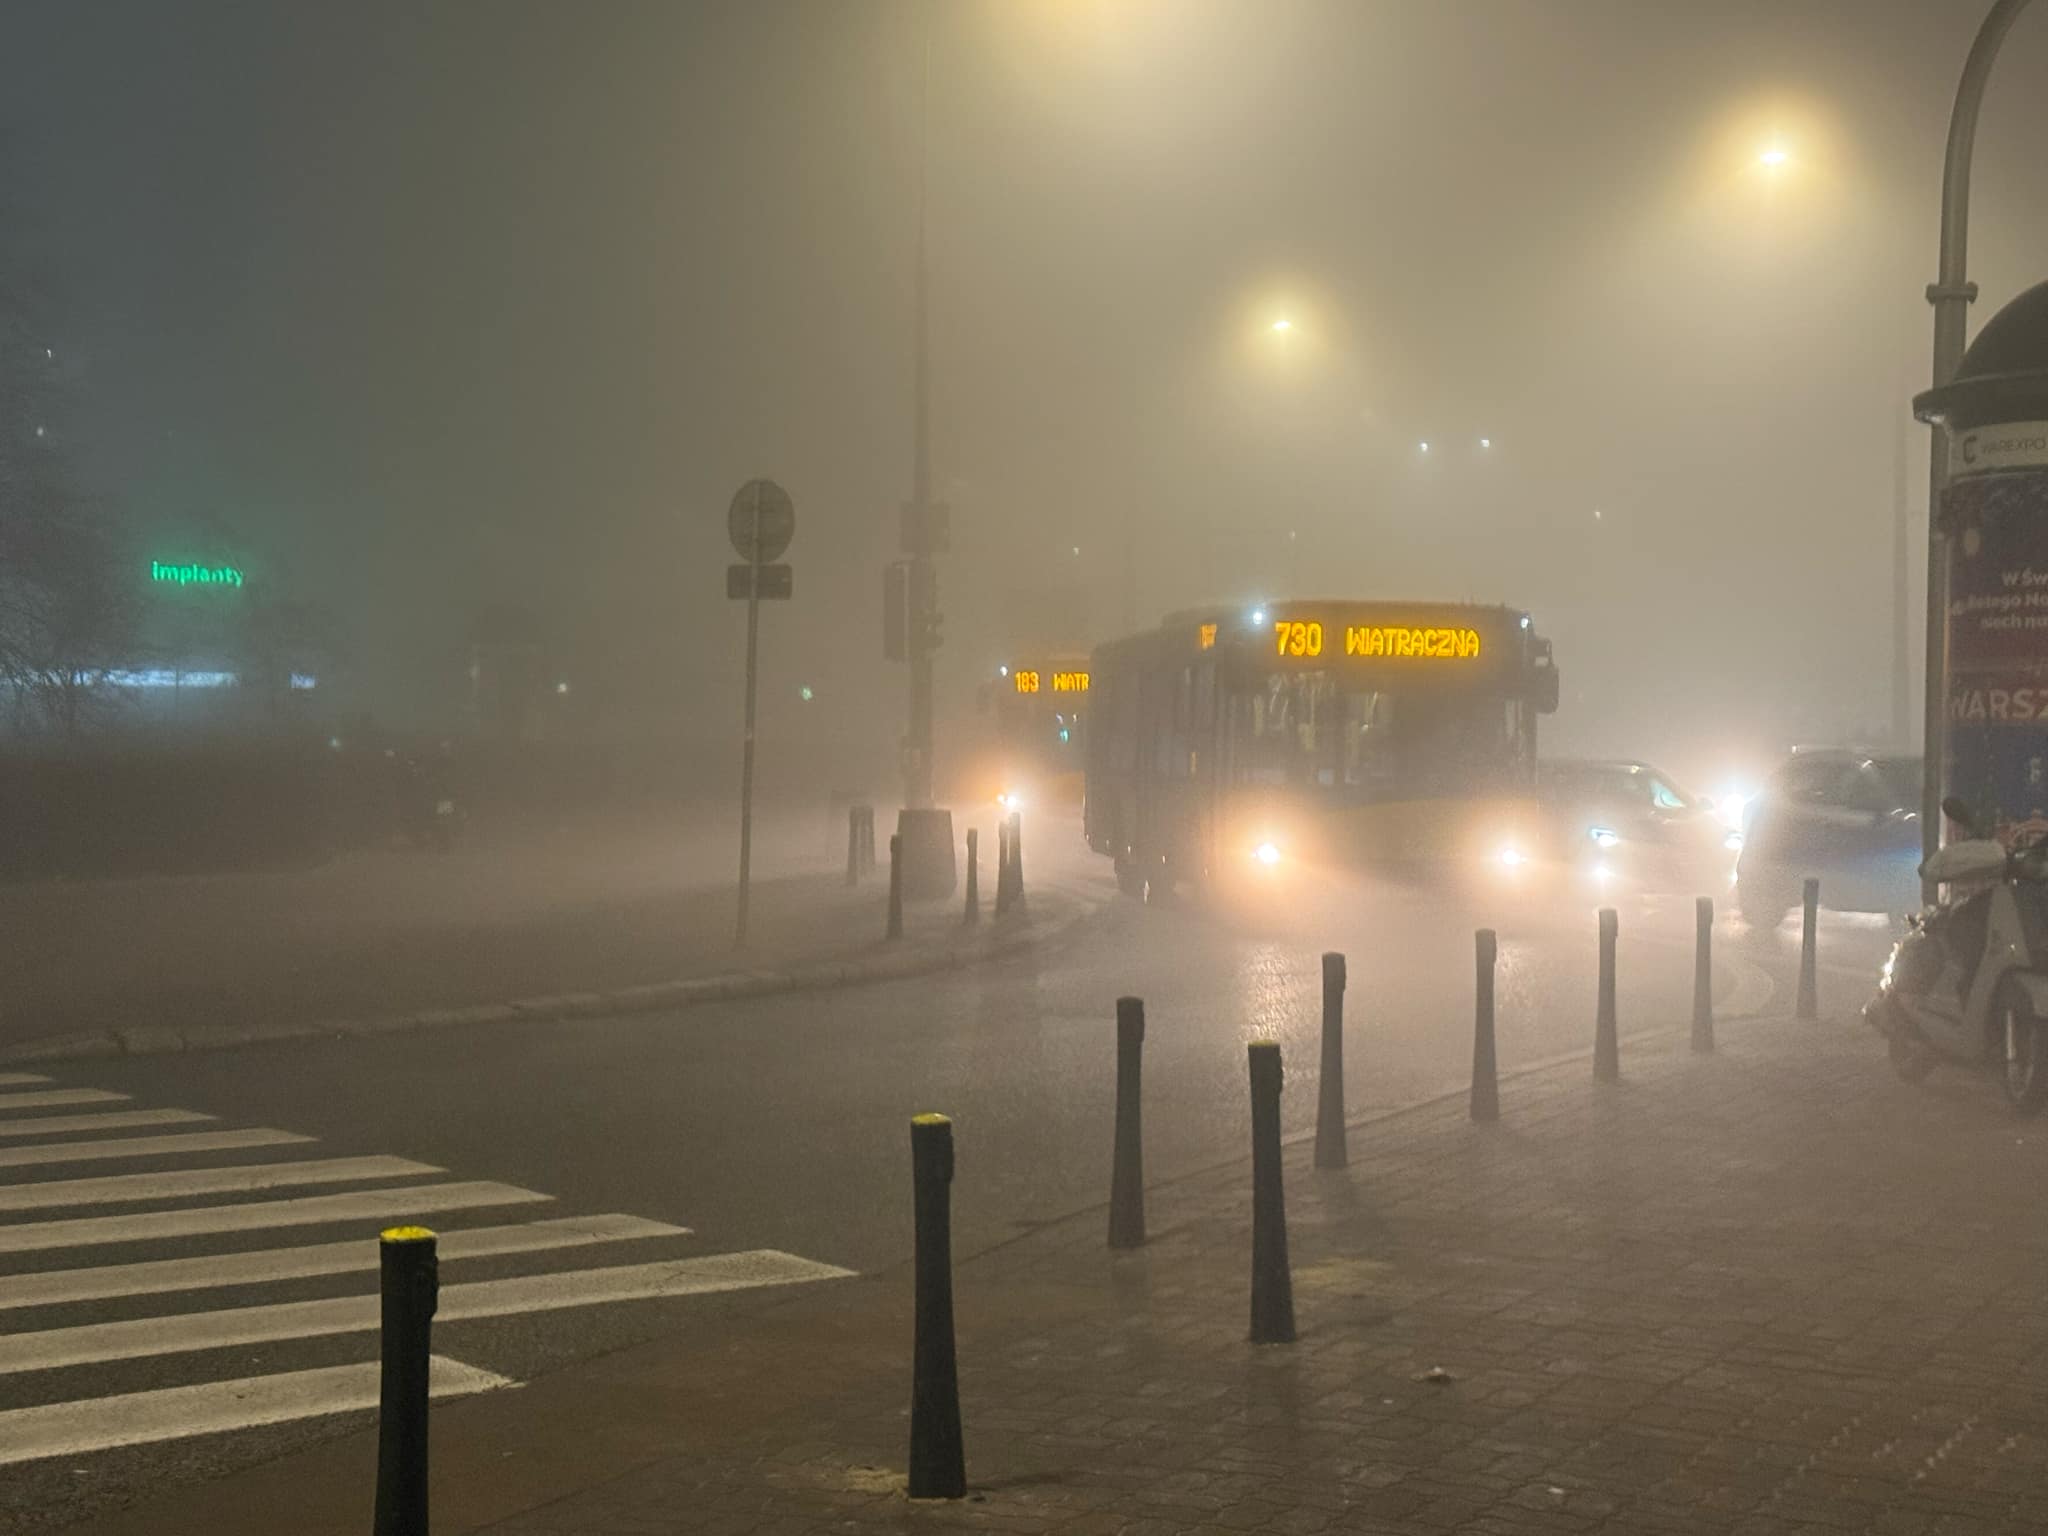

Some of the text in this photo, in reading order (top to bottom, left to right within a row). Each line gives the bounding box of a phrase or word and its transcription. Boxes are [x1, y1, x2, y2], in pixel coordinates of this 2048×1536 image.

[1275, 621, 1480, 657] 730 WIATRACZNA
[1015, 671, 1039, 693] 183
